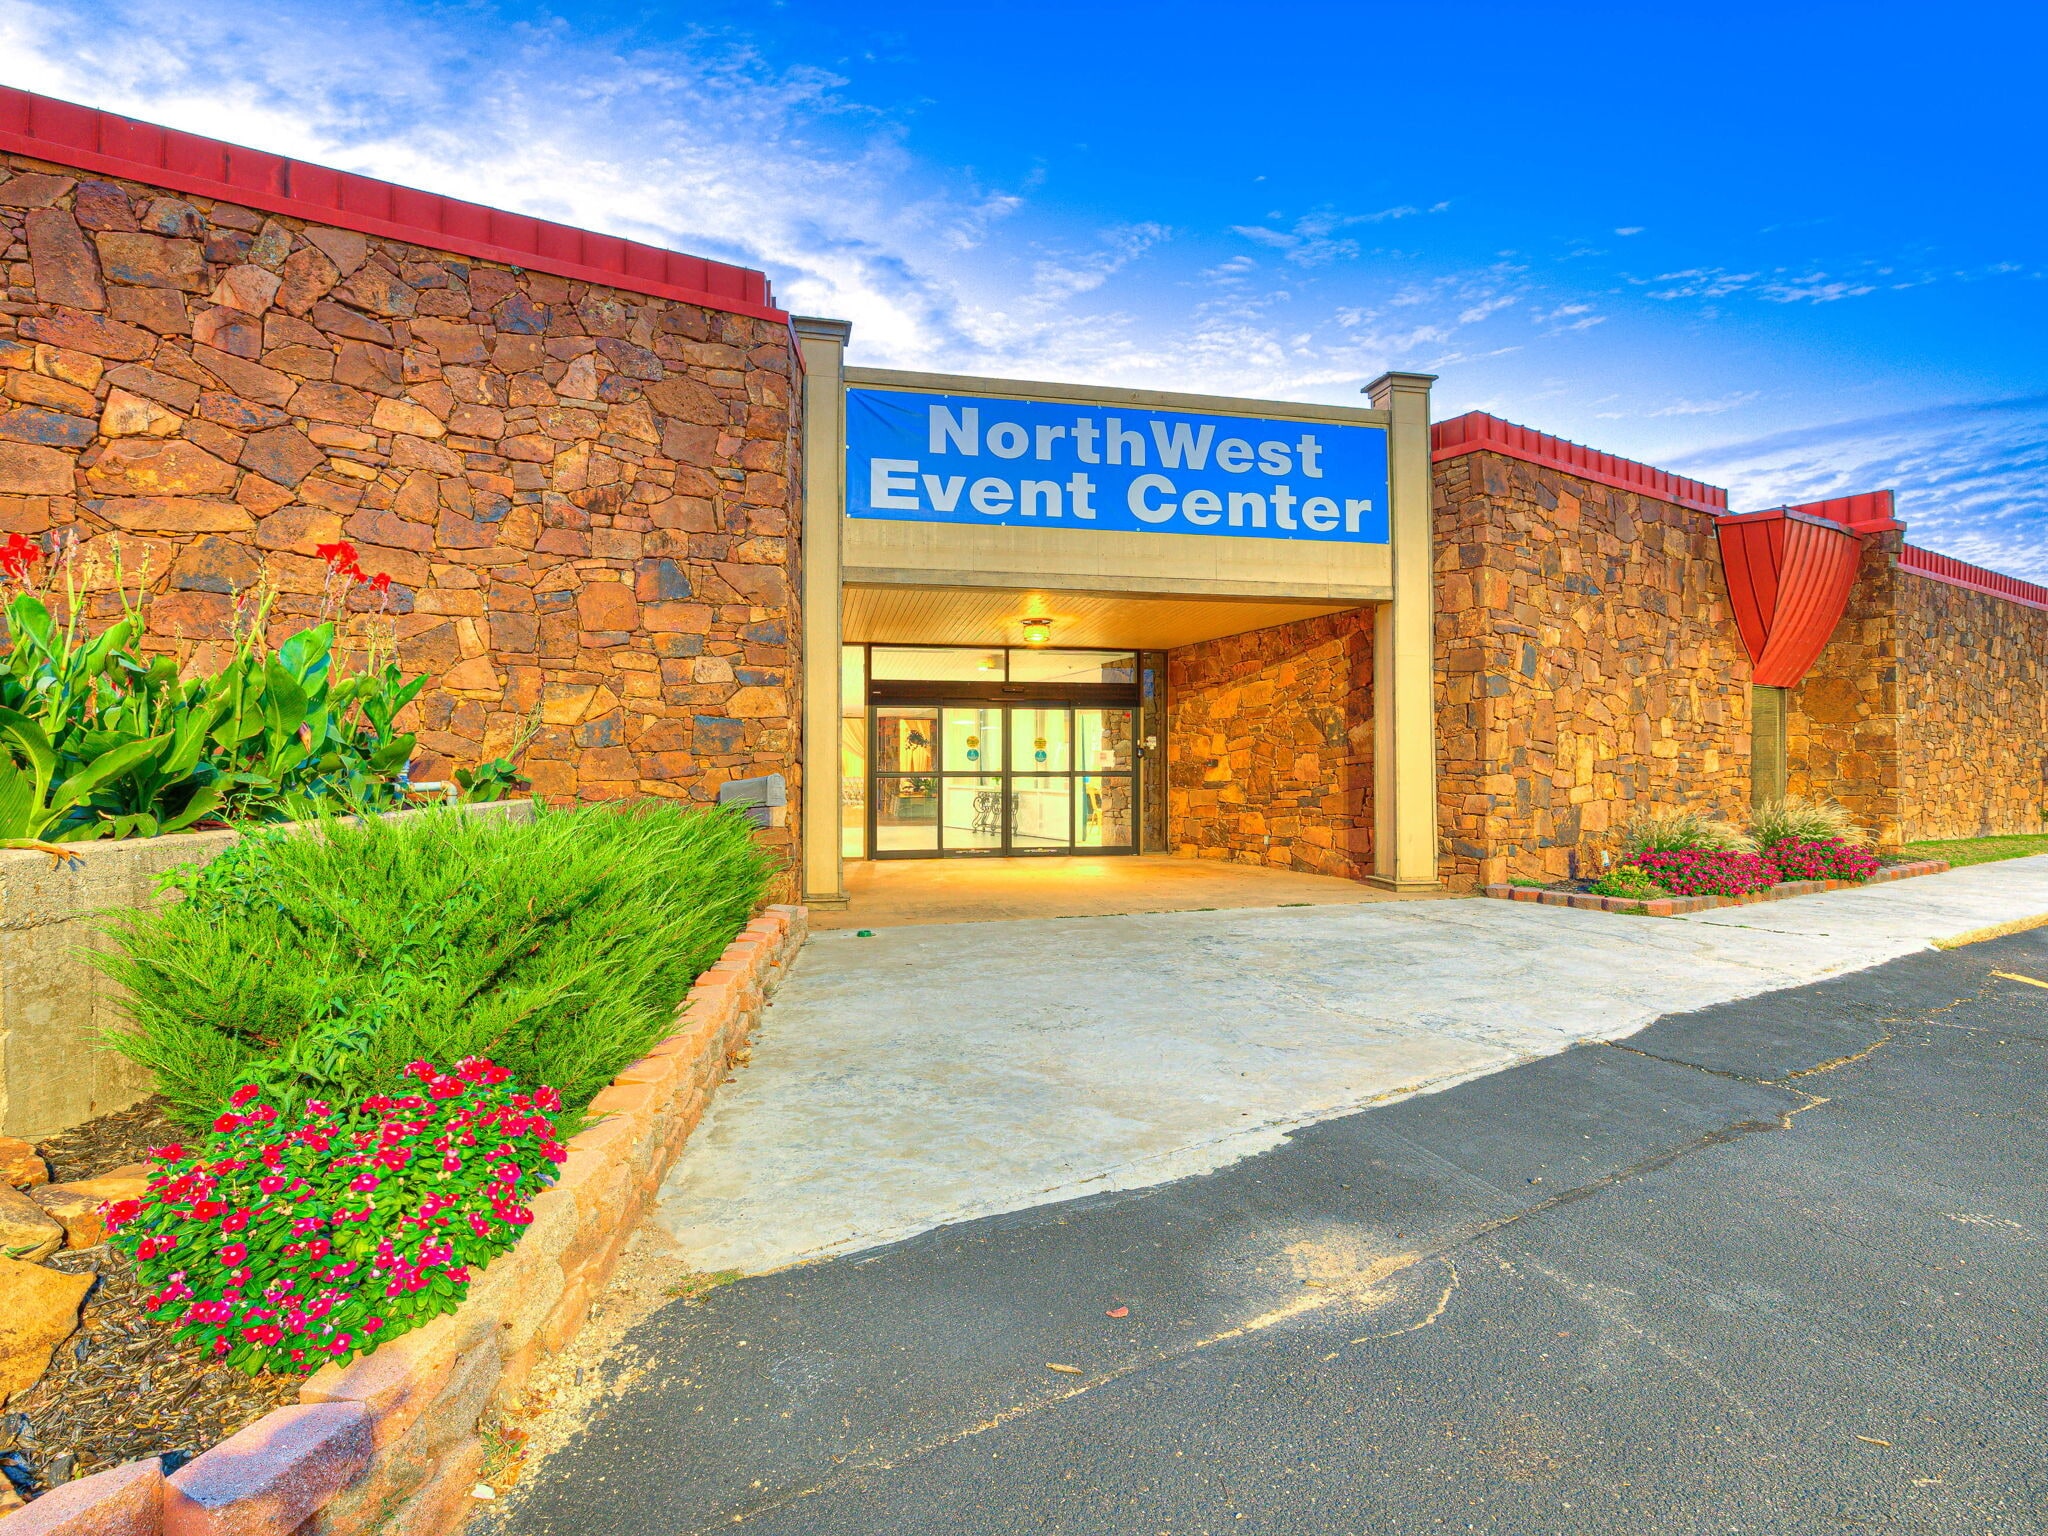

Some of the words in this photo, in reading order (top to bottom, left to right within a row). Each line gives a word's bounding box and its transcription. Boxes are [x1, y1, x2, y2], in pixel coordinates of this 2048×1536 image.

[929, 405, 1323, 478] NorthWest
[870, 458, 1097, 518] Event
[1127, 475, 1372, 533] Center
